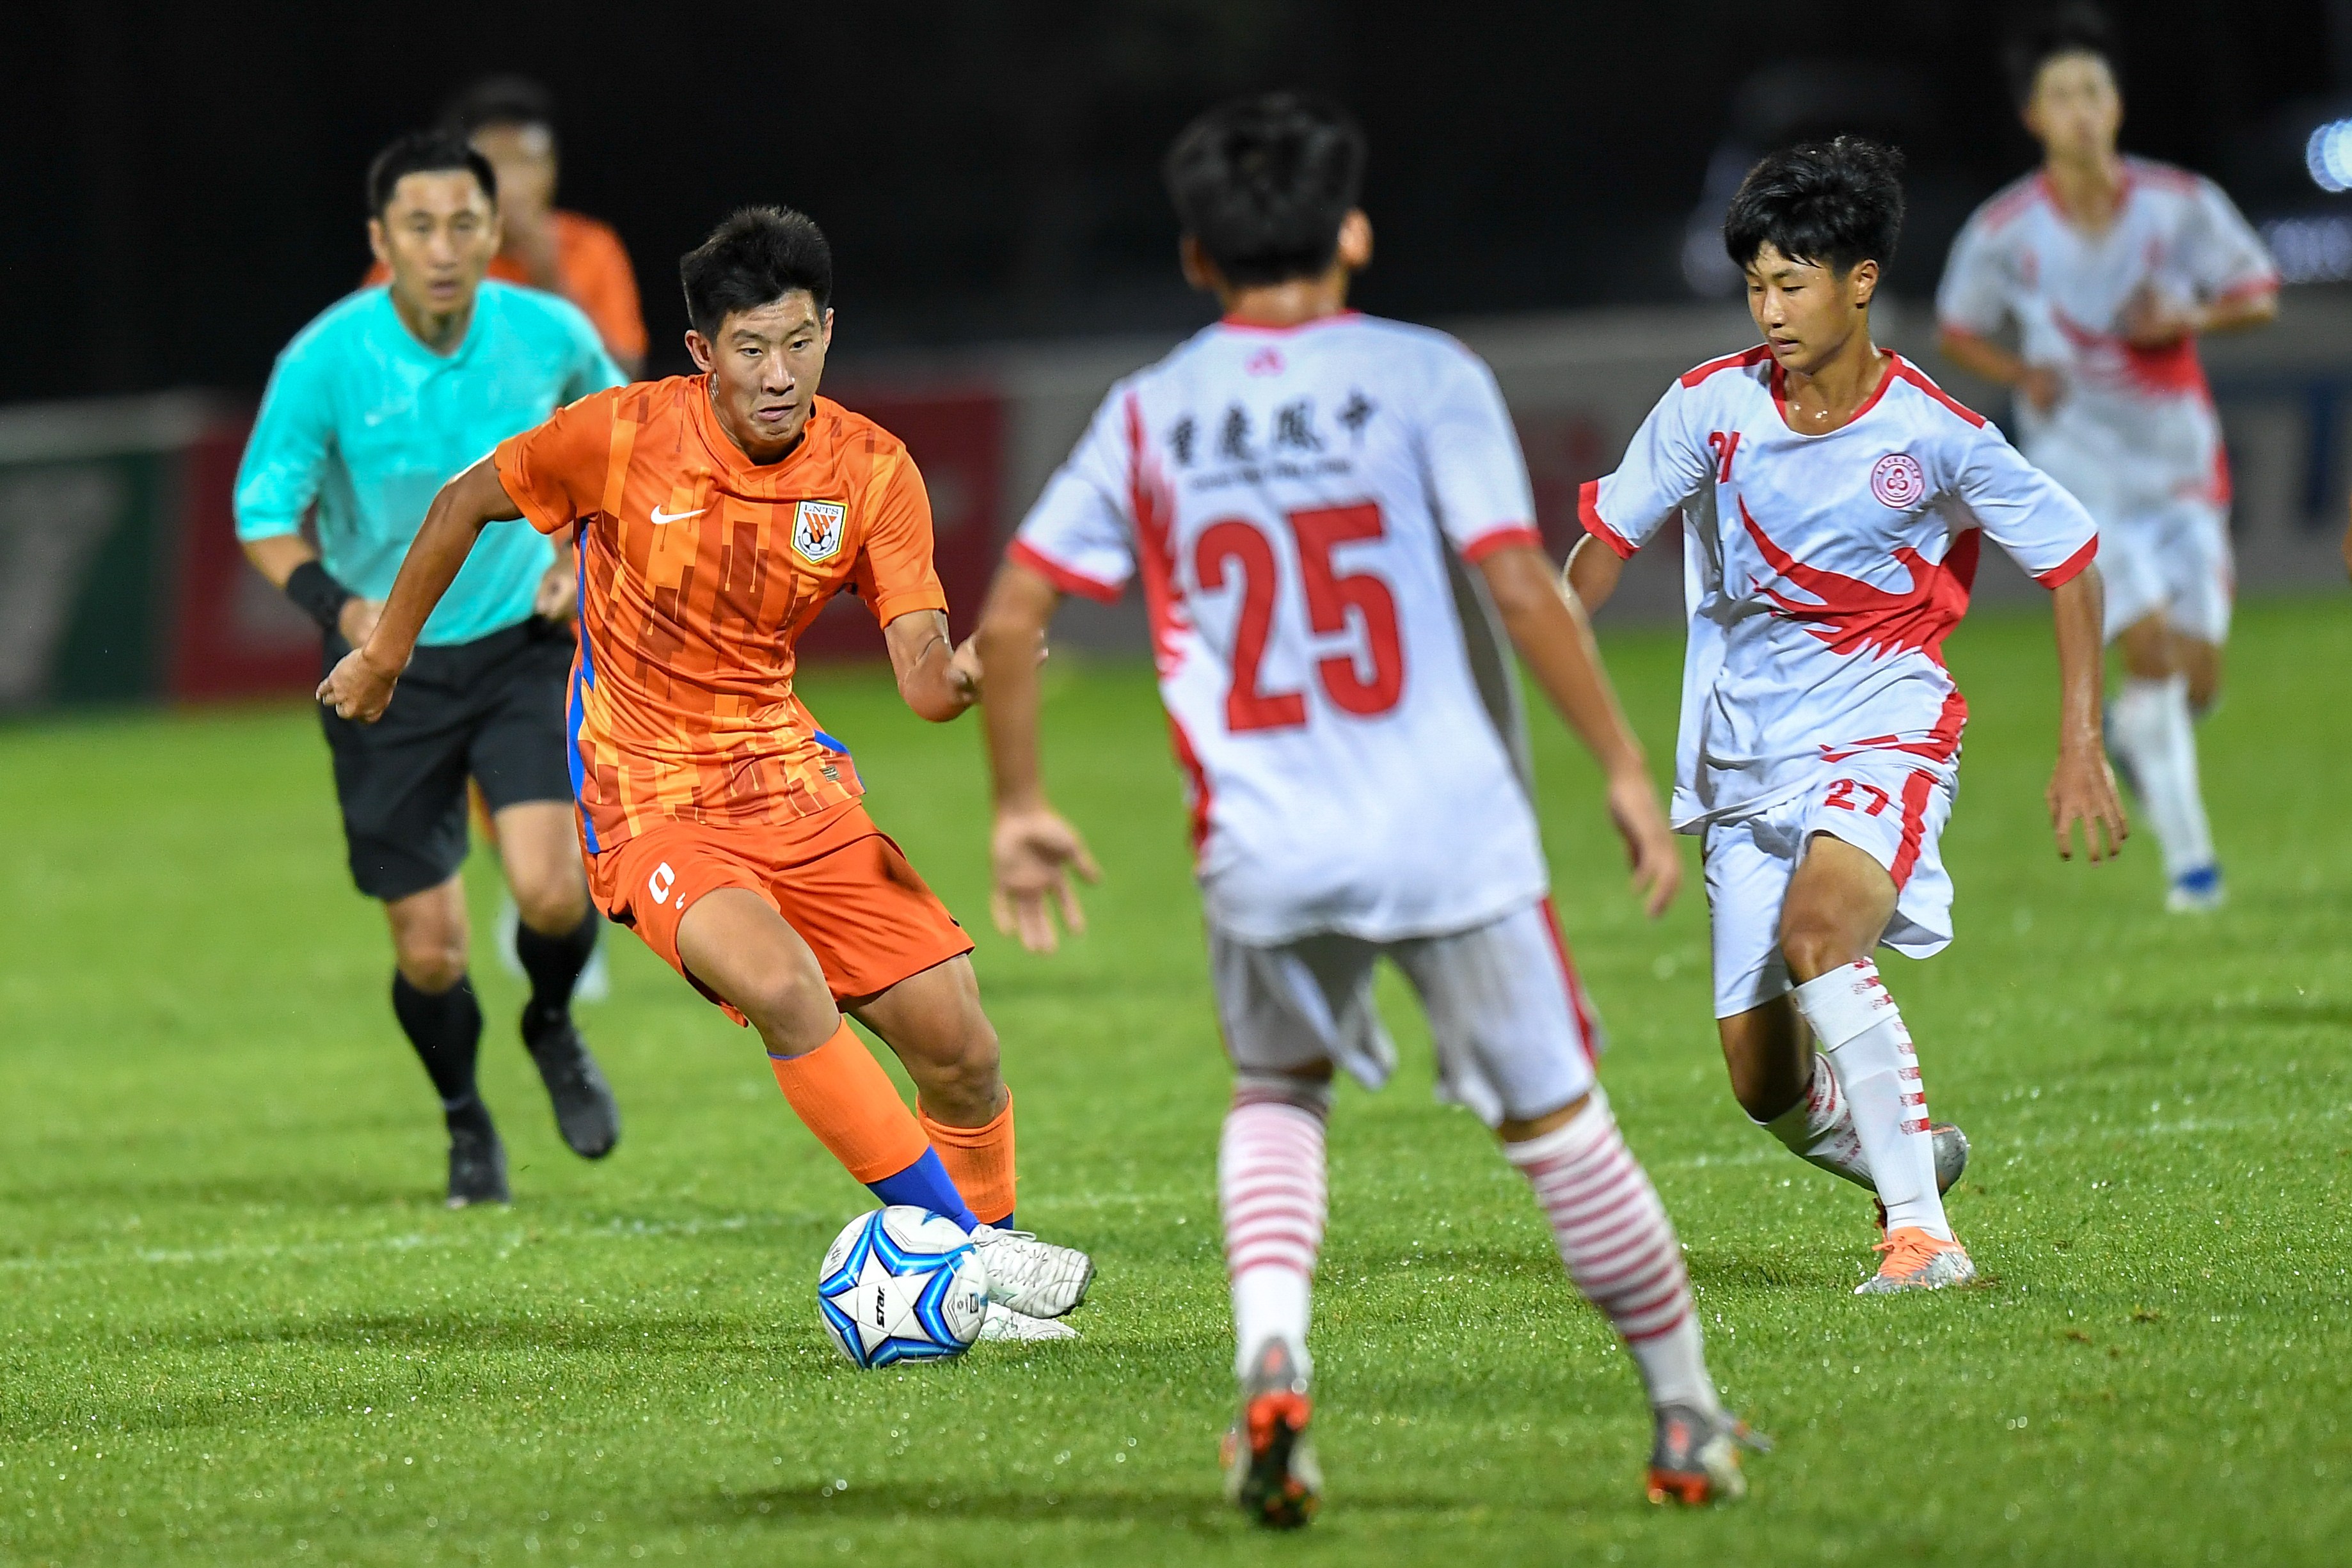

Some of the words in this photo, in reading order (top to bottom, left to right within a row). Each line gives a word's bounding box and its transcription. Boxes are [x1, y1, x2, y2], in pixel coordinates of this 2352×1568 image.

[804, 504, 839, 515] LNTS
[1195, 501, 1404, 731] 25
[1824, 779, 1889, 817] 27
